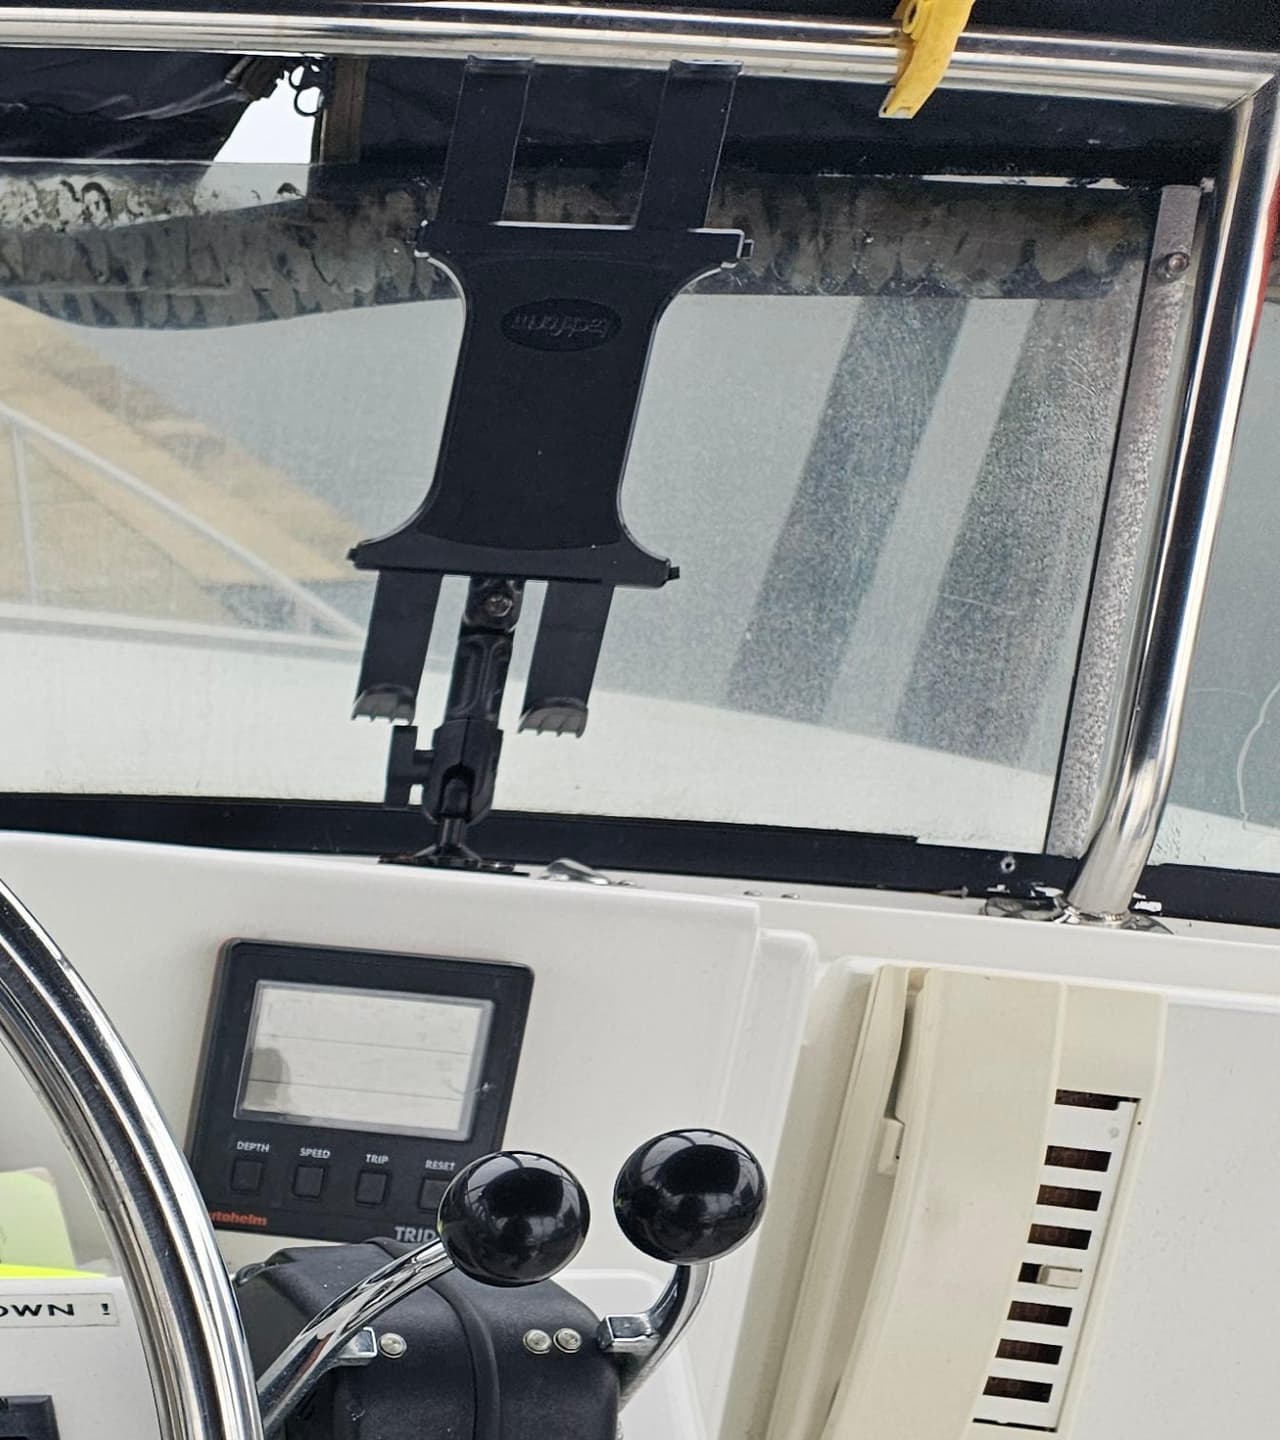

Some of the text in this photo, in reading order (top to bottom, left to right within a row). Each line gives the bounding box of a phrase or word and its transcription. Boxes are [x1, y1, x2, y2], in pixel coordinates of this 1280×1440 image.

[237, 1140, 270, 1154] DEPTH
[299, 1147, 331, 1160] SPEED
[365, 1153, 389, 1165] TRIP
[424, 1159, 456, 1172] RESET
[394, 1225, 438, 1244] TRID
